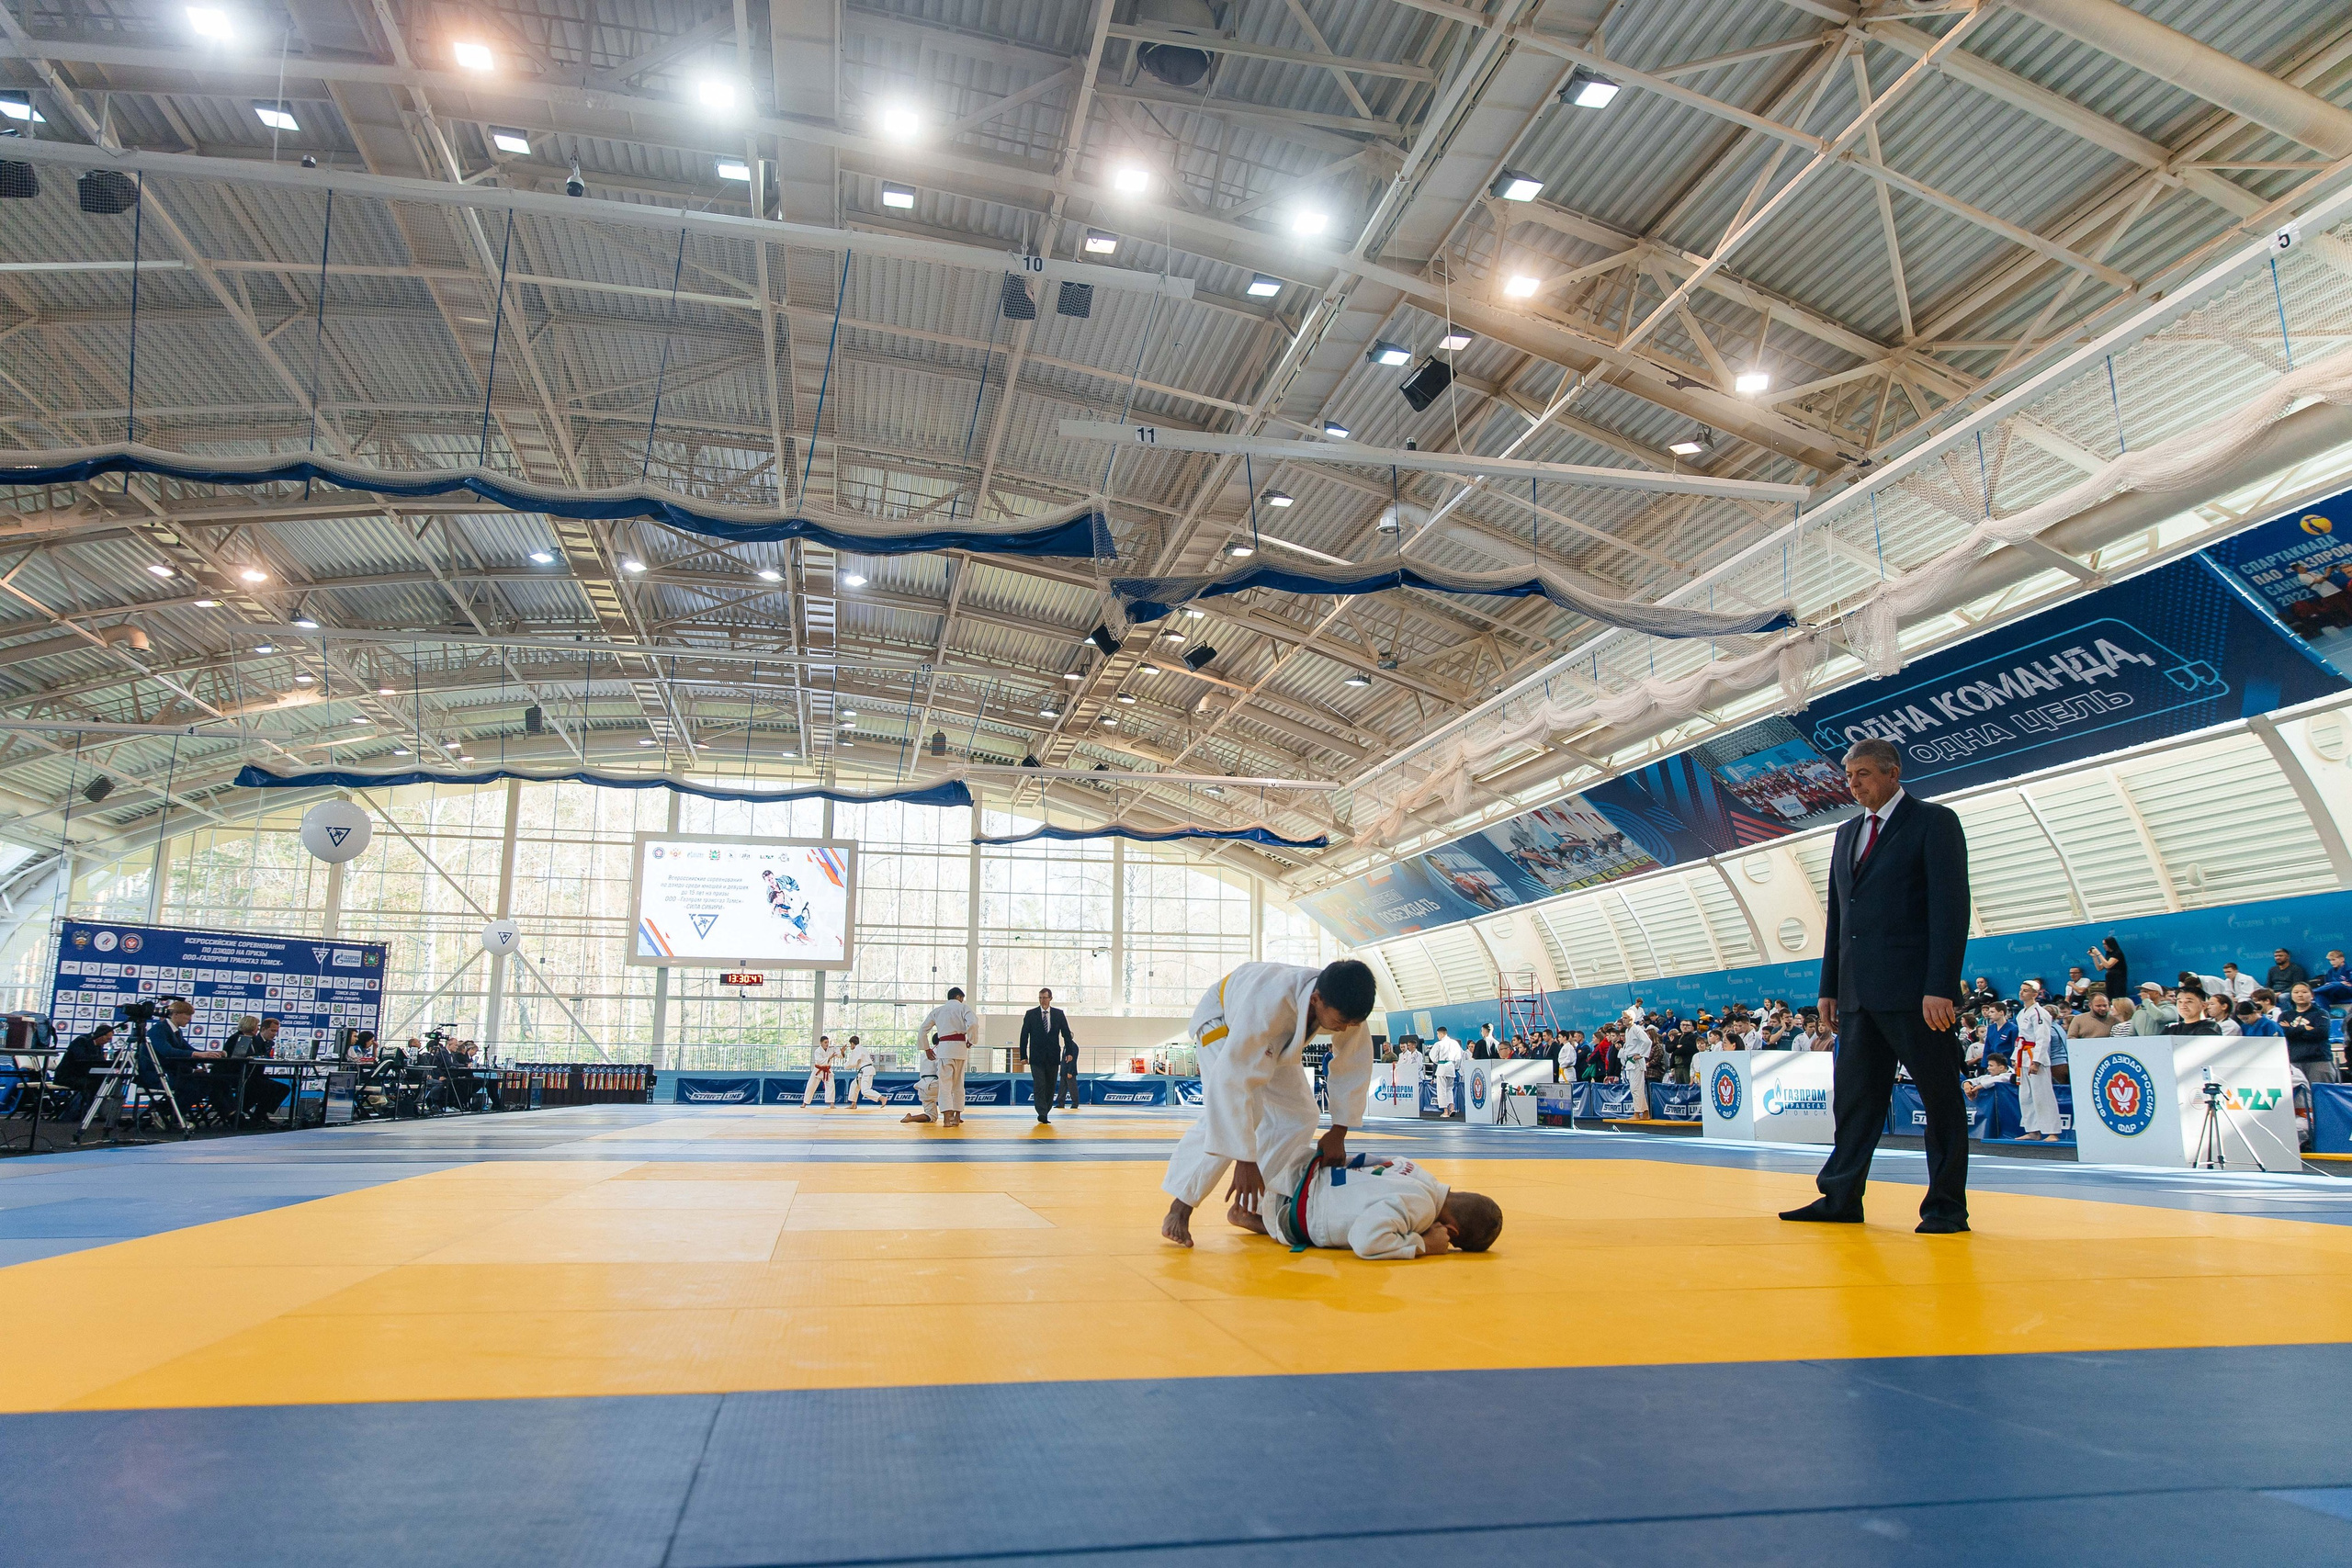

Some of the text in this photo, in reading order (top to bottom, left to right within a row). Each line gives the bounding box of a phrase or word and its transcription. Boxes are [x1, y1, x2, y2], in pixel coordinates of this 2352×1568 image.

[1023, 257, 1043, 272] 10
[1136, 427, 1155, 443] 11
[2239, 535, 2340, 574] СПАРТАКИАДА
[2251, 570, 2283, 585] ПАО
[2277, 589, 2314, 606] 2022
[1844, 638, 2156, 745] ОДНА КОМАНДА,
[187, 727, 194, 735] 4
[1908, 690, 2133, 763] ОДНА ЦЕЛЬ
[1377, 897, 1441, 924] ПОБЕЖДАТЬ
[185, 937, 286, 950] ВСЕРОССИЙСКИЕ СОРЕВНОВАНИЯ
[729, 975, 763, 983] 13:30:47
[2093, 1055, 2154, 1118] ФЕДЕРАЦИЯ ДЗЮДО РОССИИ
[1783, 1089, 1826, 1101] ГАЗПРОМ
[1603, 1103, 1621, 1111] START
[1665, 1106, 1685, 1114] START
